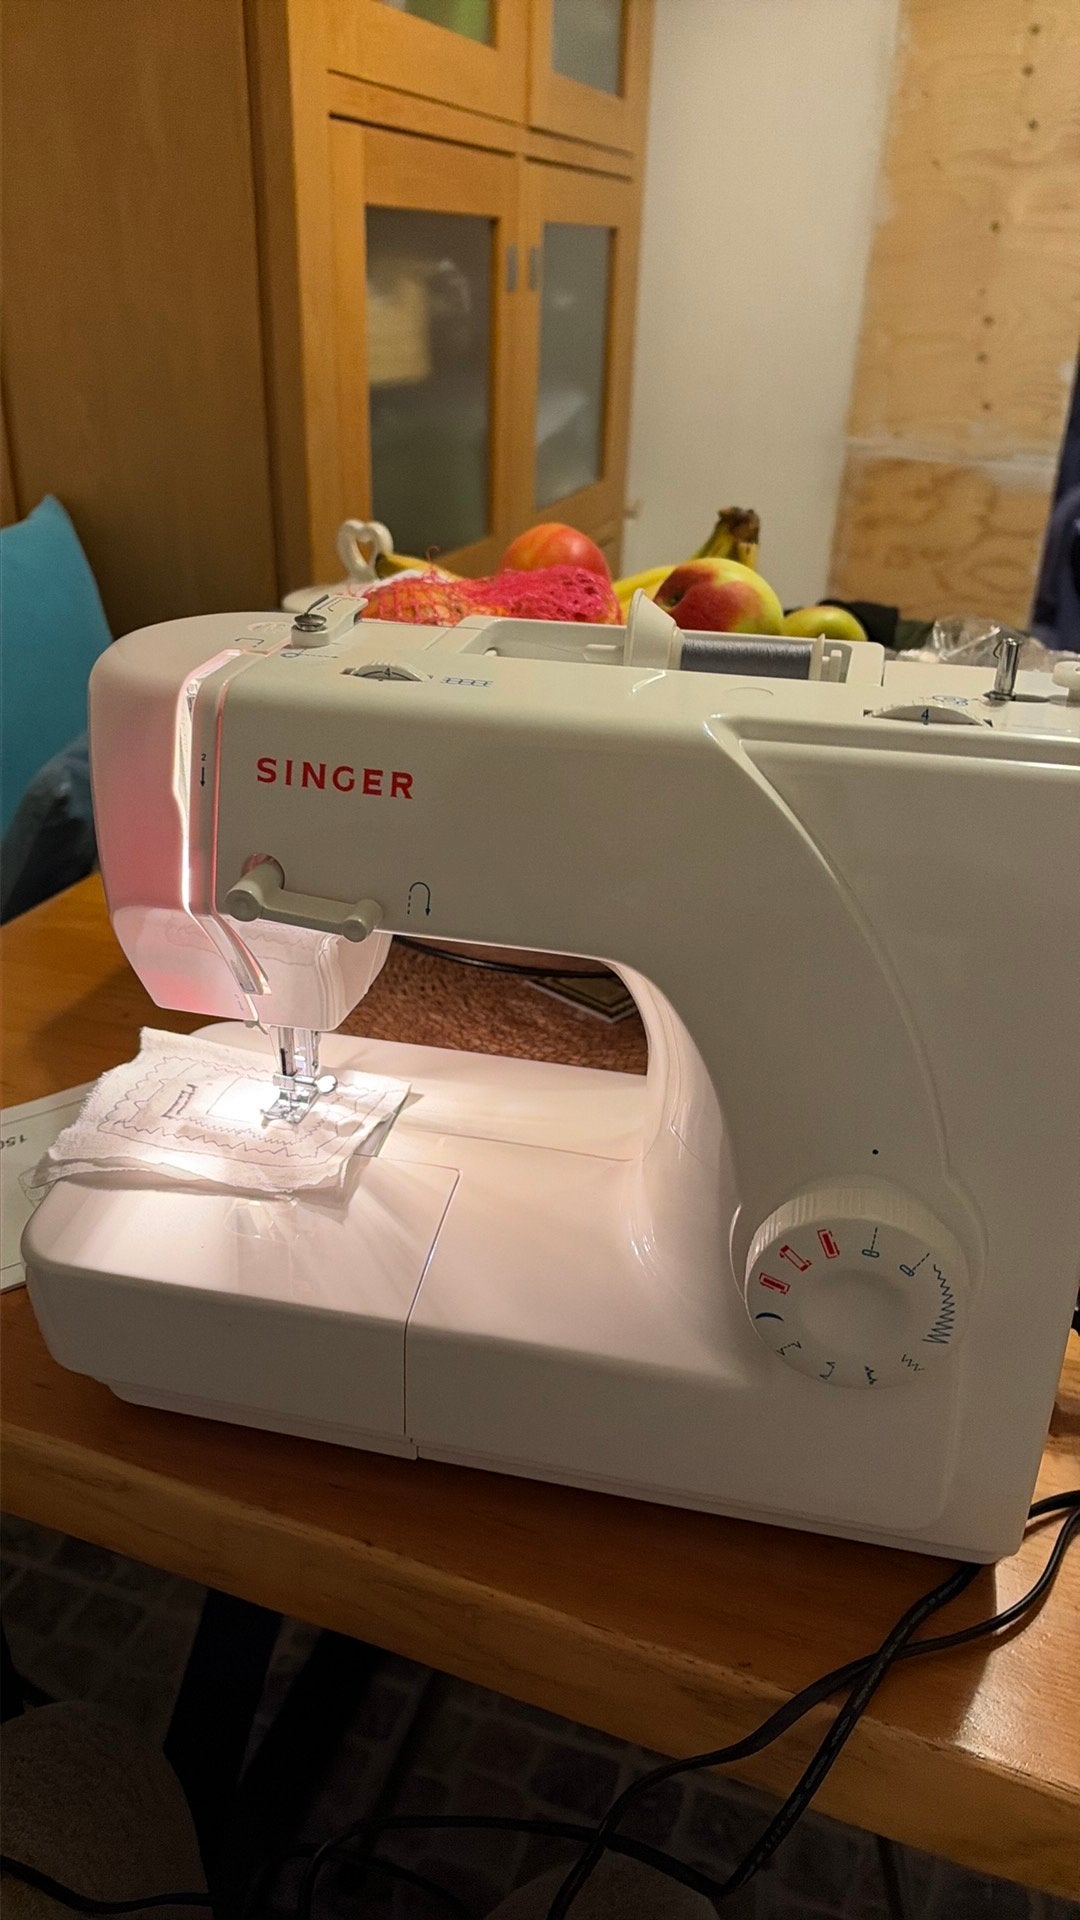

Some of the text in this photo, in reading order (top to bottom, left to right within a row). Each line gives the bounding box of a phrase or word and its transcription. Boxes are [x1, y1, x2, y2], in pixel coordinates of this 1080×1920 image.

[384, 667, 391, 678] 4
[921, 708, 929, 721] 4
[201, 753, 207, 761] 2
[256, 757, 414, 800] SINGER
